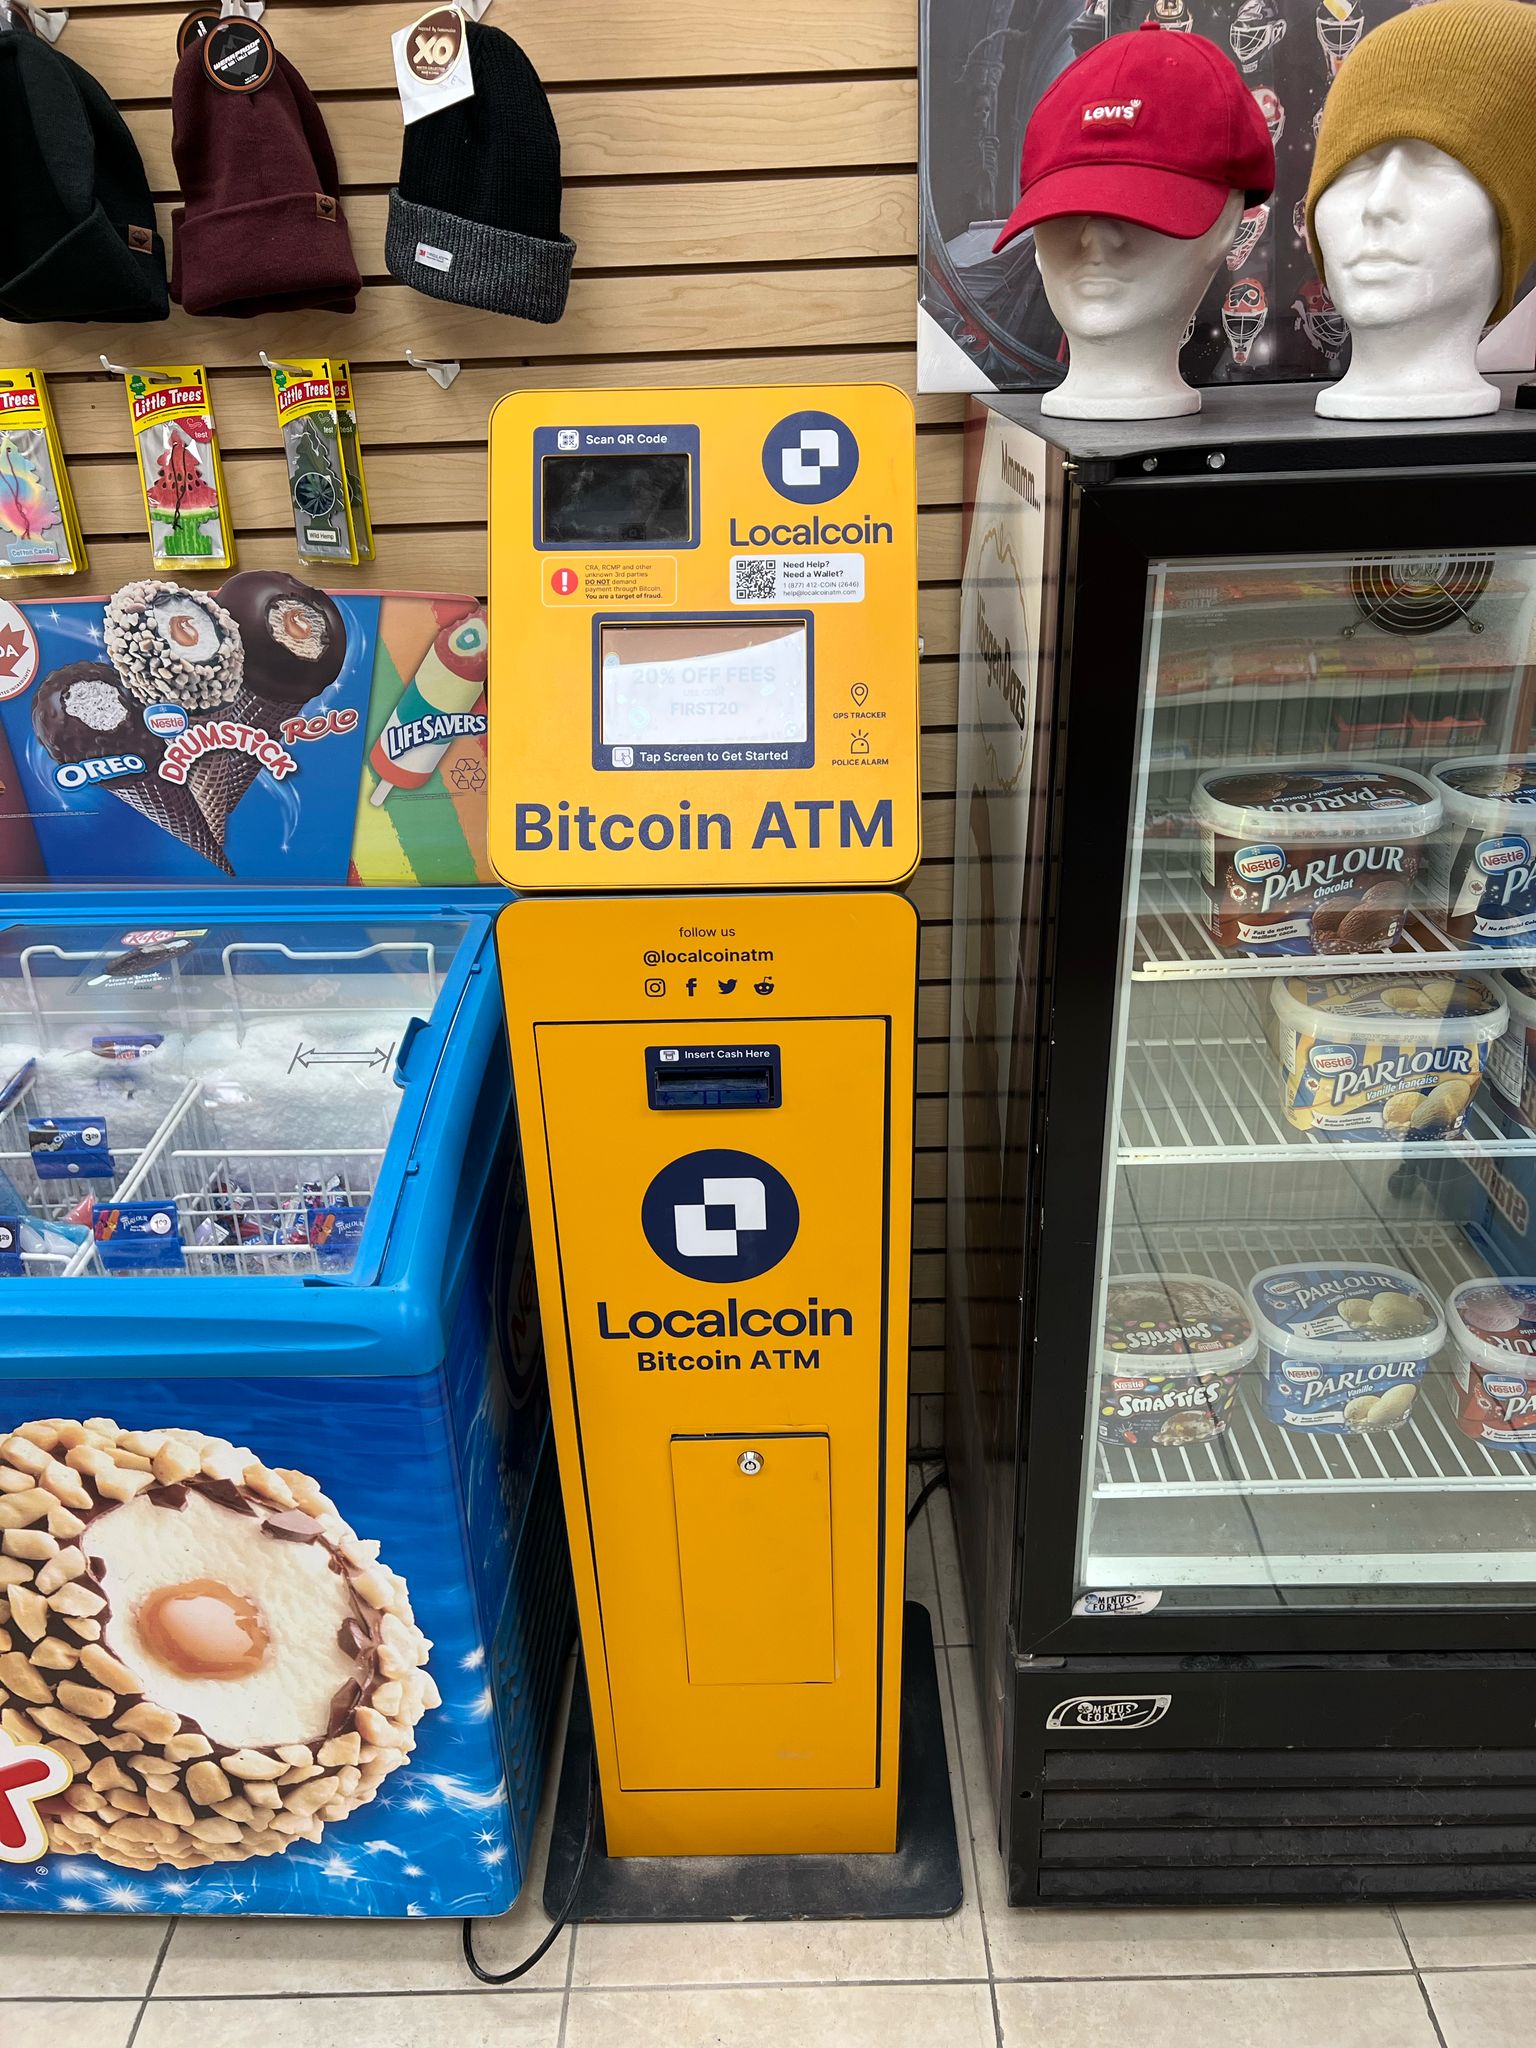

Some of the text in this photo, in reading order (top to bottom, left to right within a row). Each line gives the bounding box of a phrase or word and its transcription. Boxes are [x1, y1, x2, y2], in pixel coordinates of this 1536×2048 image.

[213, 38, 261, 71] WEARPROOF
[413, 33, 454, 66] XO
[193, 368, 202, 385] 1
[321, 362, 329, 379] 1
[338, 363, 347, 379] 1
[26, 371, 36, 388] 1
[2, 392, 37, 408] Trees
[135, 393, 167, 418] Little
[169, 388, 202, 405] Trees
[279, 385, 303, 411] Little
[303, 382, 329, 398] Trees
[585, 433, 668, 446] Scan QR Code
[729, 514, 893, 547] Localcoin
[12, 547, 54, 558] Cotton Candy
[783, 560, 830, 569] Need Help?
[626, 571, 649, 579] parties
[783, 570, 805, 578] Need
[813, 570, 844, 579] Wallet?
[838, 581, 860, 589] (2646)
[783, 589, 857, 598] help@localcoinatm.com
[632, 665, 777, 685] 20% OFF FEES
[670, 702, 740, 716] FIRST20
[850, 711, 887, 719] TRACKER
[150, 716, 184, 731] Nestlé
[640, 750, 789, 764] Tap Screen to Get Started
[832, 758, 889, 766] POLICE ALARM
[56, 755, 143, 788] OREO
[515, 799, 893, 851] Bitcoin ATM
[1241, 857, 1281, 874] Nestlé
[1482, 850, 1524, 867] Nestlé
[1261, 846, 1404, 913] PARLOUR
[1313, 877, 1354, 899] chocolat
[678, 926, 736, 938] follow us
[1276, 924, 1294, 933] notre
[1278, 928, 1298, 937] cacao
[643, 948, 774, 967] @localcoinatm
[684, 1049, 770, 1059] Insert Cash Here
[1315, 1055, 1353, 1069] Nestlé
[1333, 1050, 1471, 1105] PARLOUR
[1366, 1074, 1439, 1101] Vanille française
[53, 1130, 77, 1143] OREO
[1295, 1275, 1400, 1310] PARLOUR
[596, 1296, 853, 1340] Localcoin
[637, 1348, 820, 1372] Bitcoin ATM
[1287, 1368, 1320, 1379] Nestlé
[1113, 1381, 1145, 1391] Nestlé
[1303, 1361, 1417, 1406] PARLOUR
[1347, 1384, 1375, 1398] Vanille
[1093, 1602, 1126, 1612] FORTY
[1098, 1595, 1132, 1605] MINUS
[1087, 1712, 1126, 1722] FORTY
[1092, 1704, 1132, 1715] MINUS
